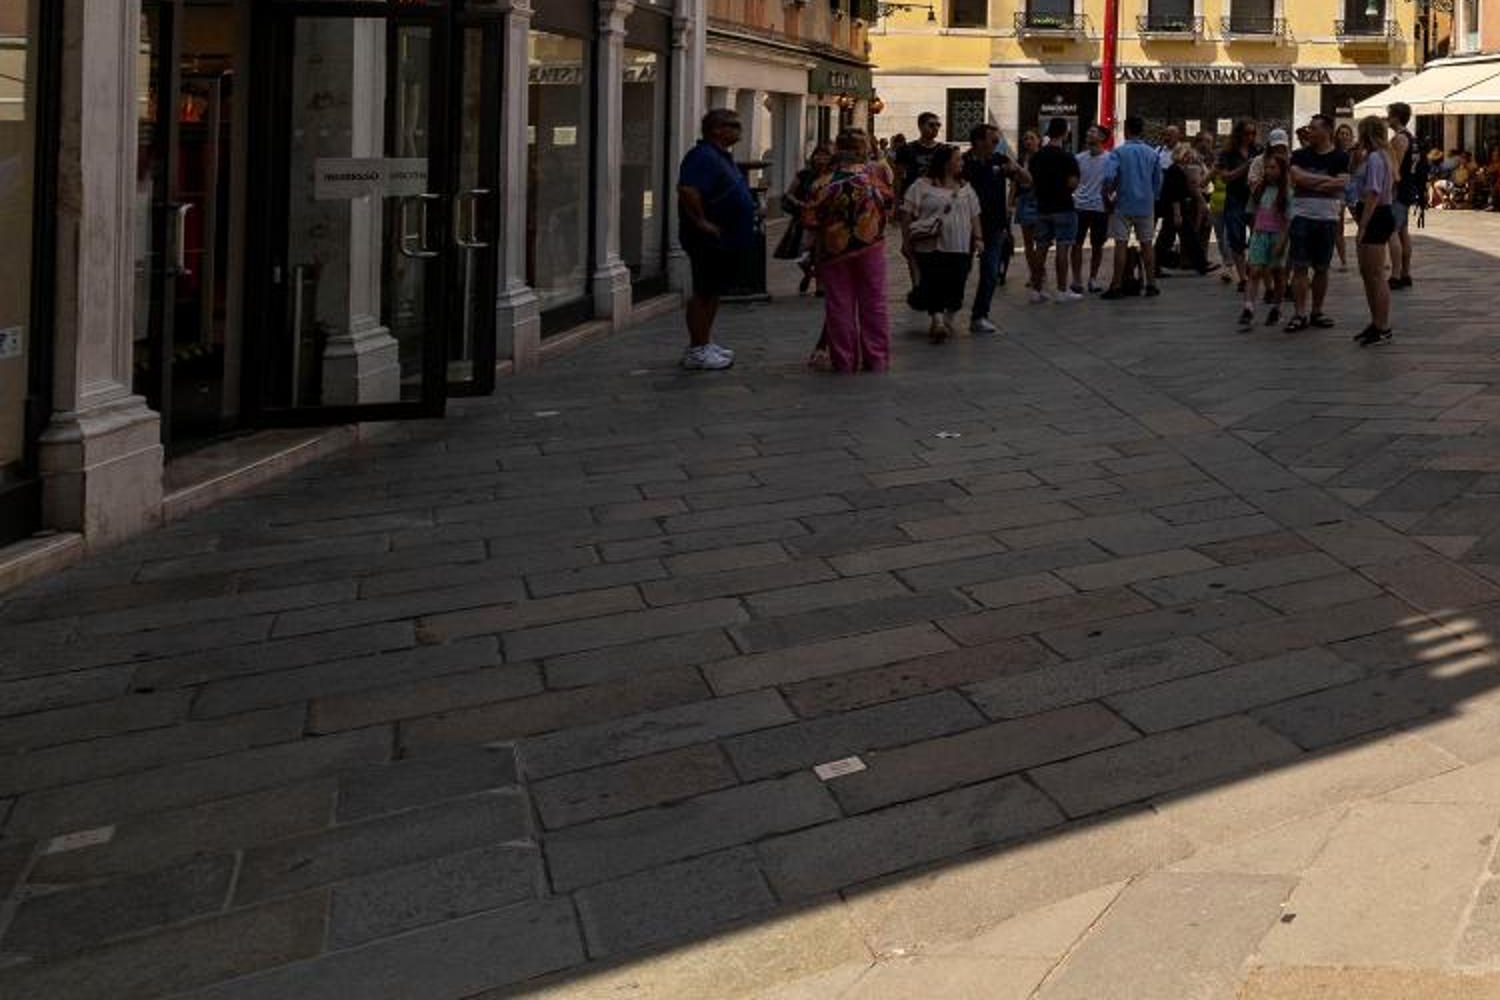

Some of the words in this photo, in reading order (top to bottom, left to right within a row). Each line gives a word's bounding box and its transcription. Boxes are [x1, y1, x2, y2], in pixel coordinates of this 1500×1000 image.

[1115, 68, 1155, 82] ASSA
[1173, 68, 1254, 83] RISPARMIO
[1269, 68, 1332, 83] VENEZIA
